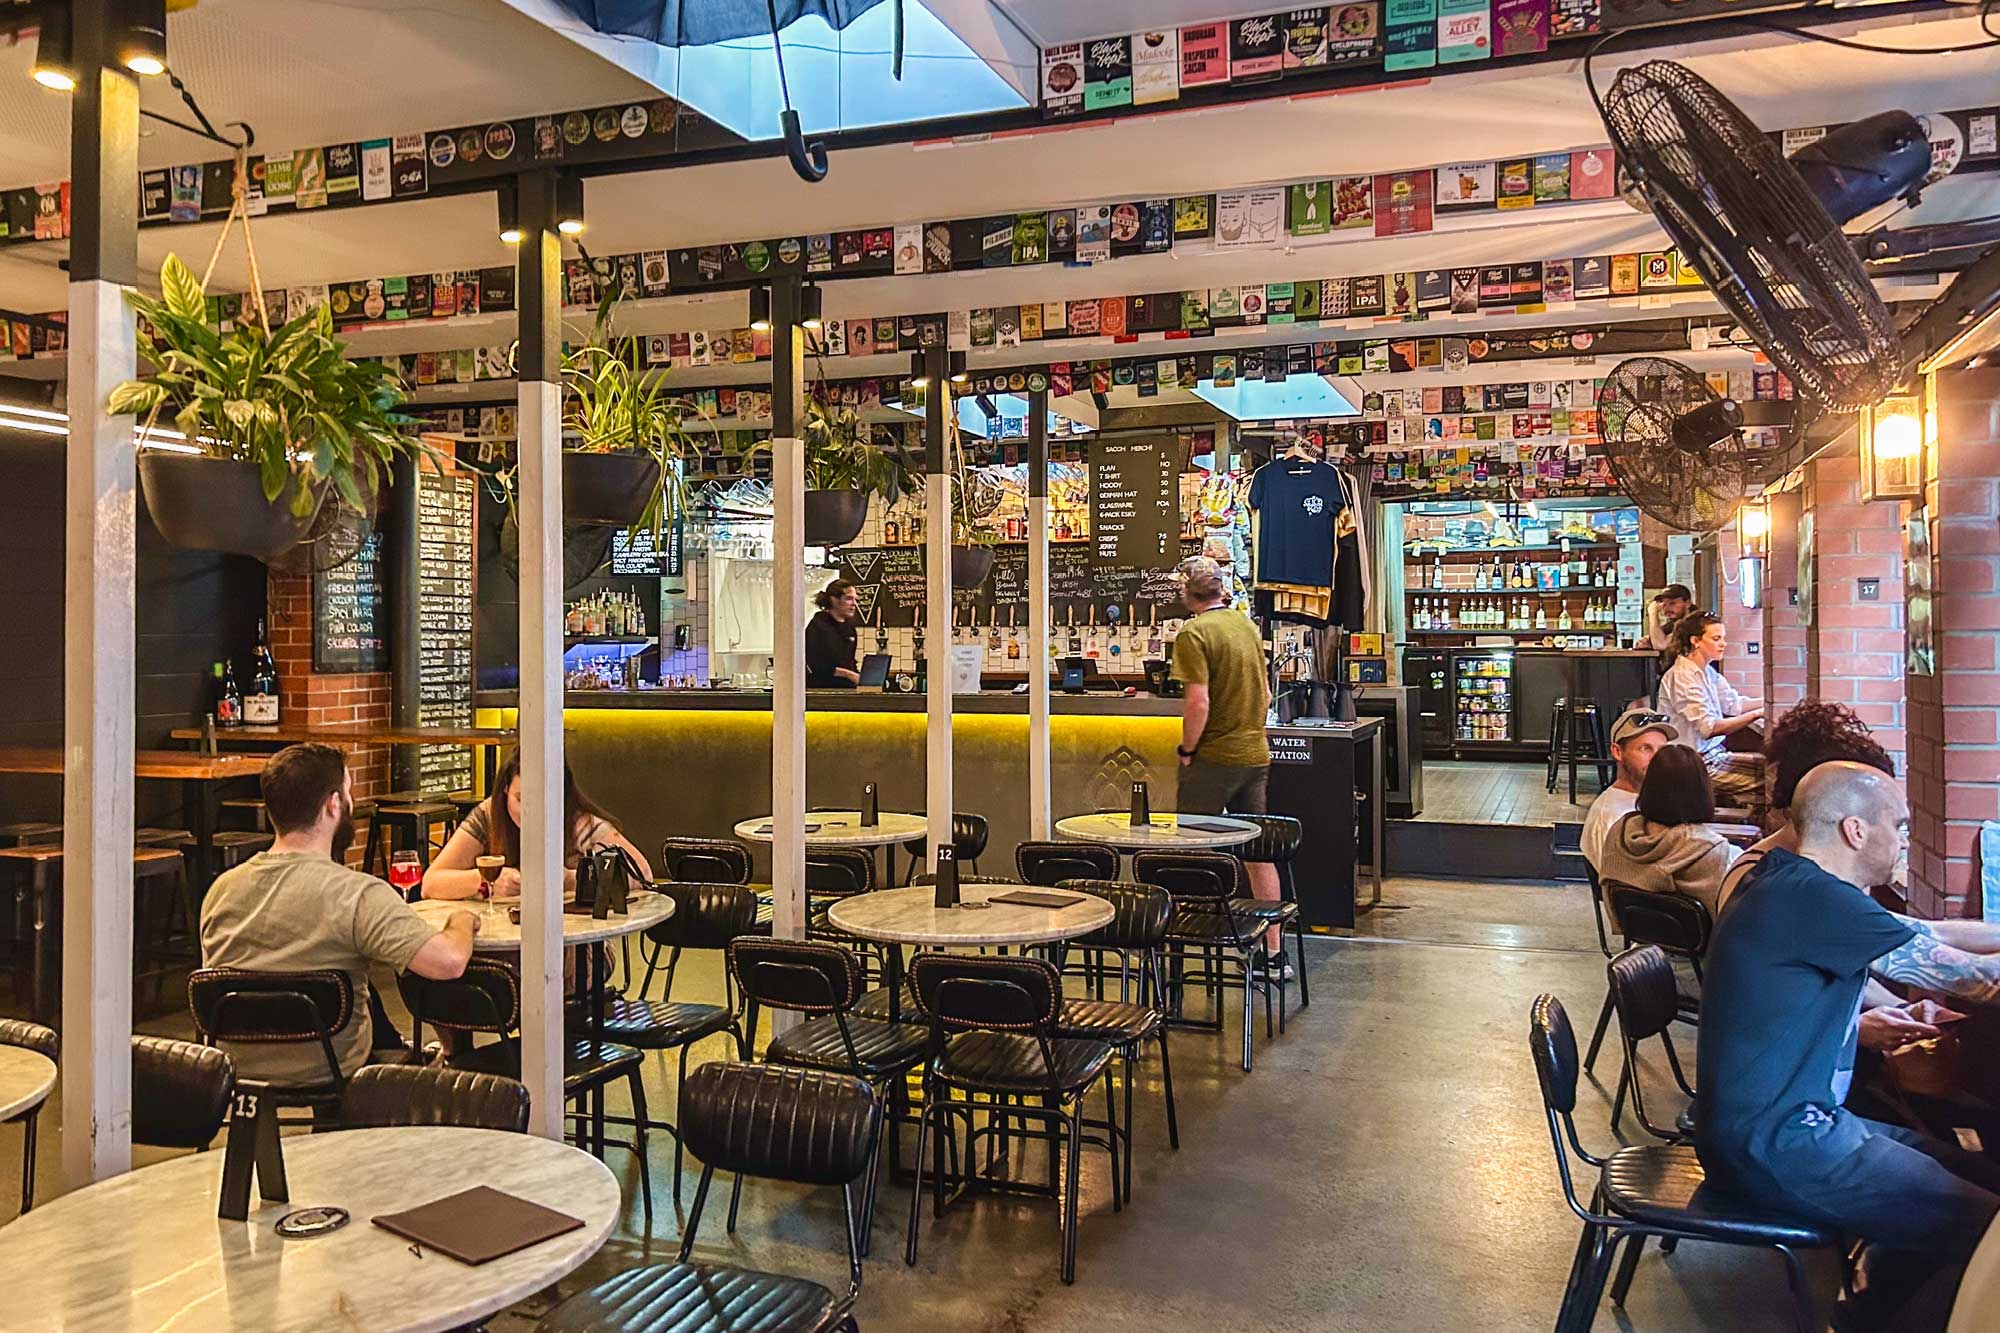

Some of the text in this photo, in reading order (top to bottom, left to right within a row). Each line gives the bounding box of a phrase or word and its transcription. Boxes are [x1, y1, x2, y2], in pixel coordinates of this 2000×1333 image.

[1241, 17, 1274, 36] Black
[1449, 24, 1480, 36] ALLEY
[1091, 39, 1123, 59] Black
[1022, 245, 1039, 258] IPA
[1356, 296, 1377, 306] IPA
[1124, 490, 1138, 498] HAT
[1863, 585, 1875, 594] 17
[1272, 738, 1306, 747] WATER
[1269, 751, 1310, 760] STATION
[865, 785, 871, 793] 6
[1133, 784, 1142, 792] 11
[939, 849, 952, 860] 12
[603, 859, 610, 870] 7
[236, 1095, 258, 1118] 13
